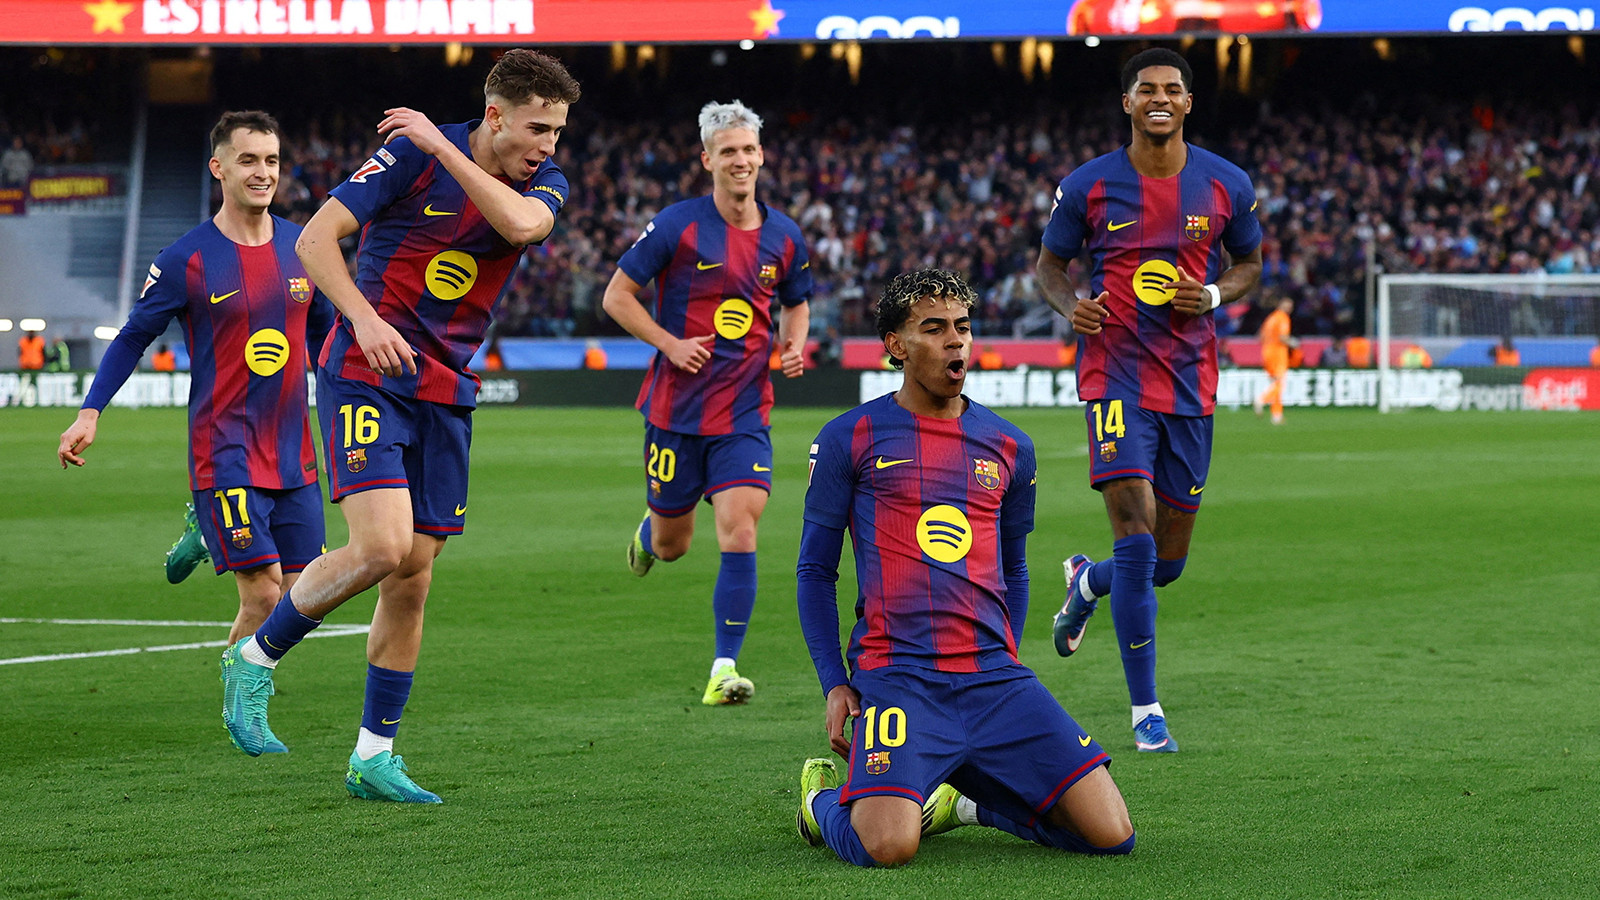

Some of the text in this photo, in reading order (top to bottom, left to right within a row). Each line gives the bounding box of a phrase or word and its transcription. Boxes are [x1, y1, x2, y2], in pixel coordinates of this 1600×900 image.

[338, 403, 381, 449] 16
[1092, 399, 1126, 442] 14
[647, 442, 677, 483] 20
[214, 487, 251, 529] 17
[863, 705, 908, 751] 10
